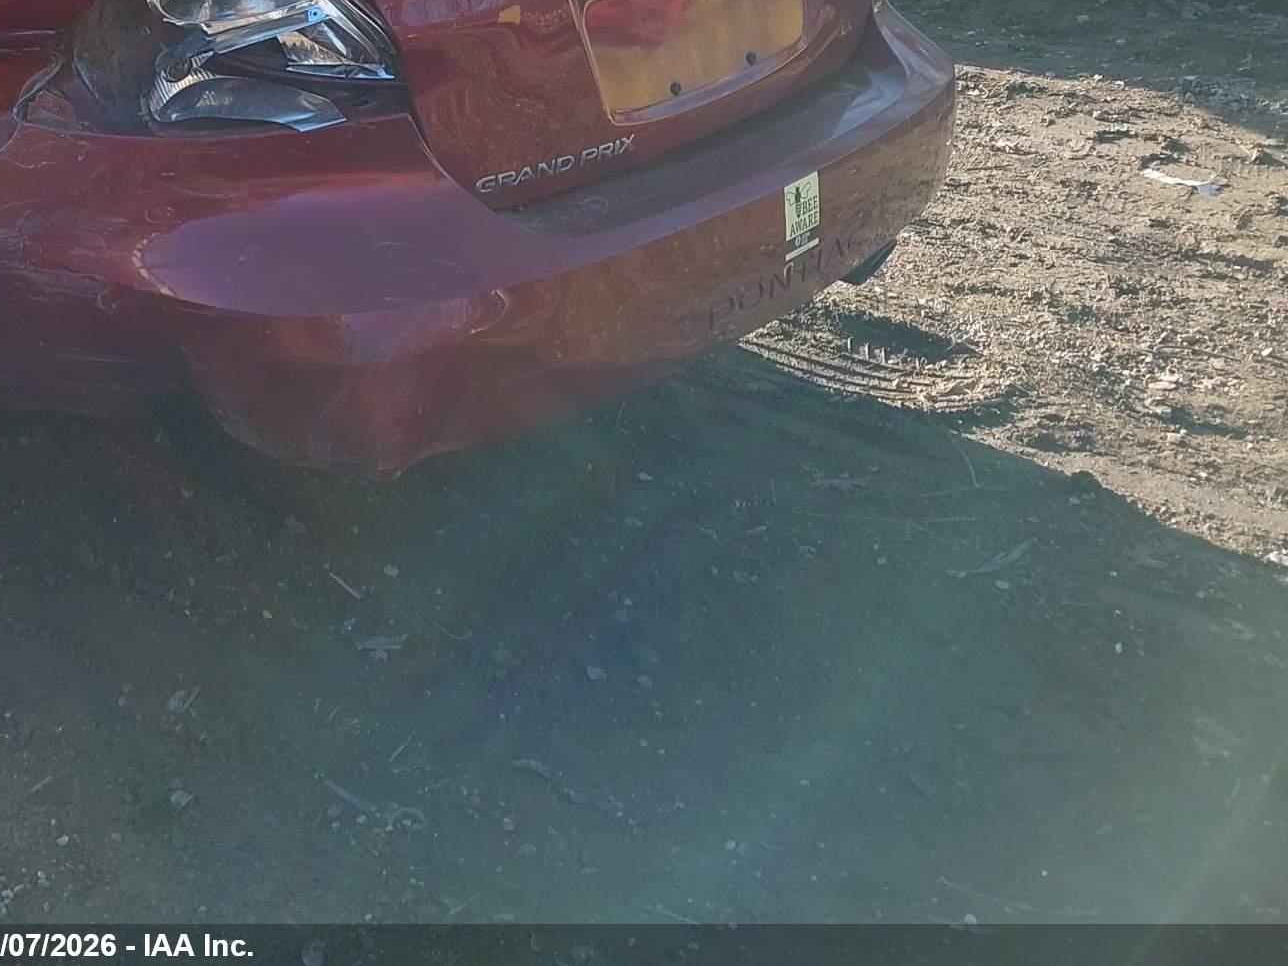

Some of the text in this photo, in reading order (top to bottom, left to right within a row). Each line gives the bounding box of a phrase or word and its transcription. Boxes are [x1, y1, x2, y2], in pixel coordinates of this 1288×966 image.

[475, 132, 635, 194] GRAND PRIX
[801, 195, 819, 216] BEE
[789, 211, 819, 238] AWARE
